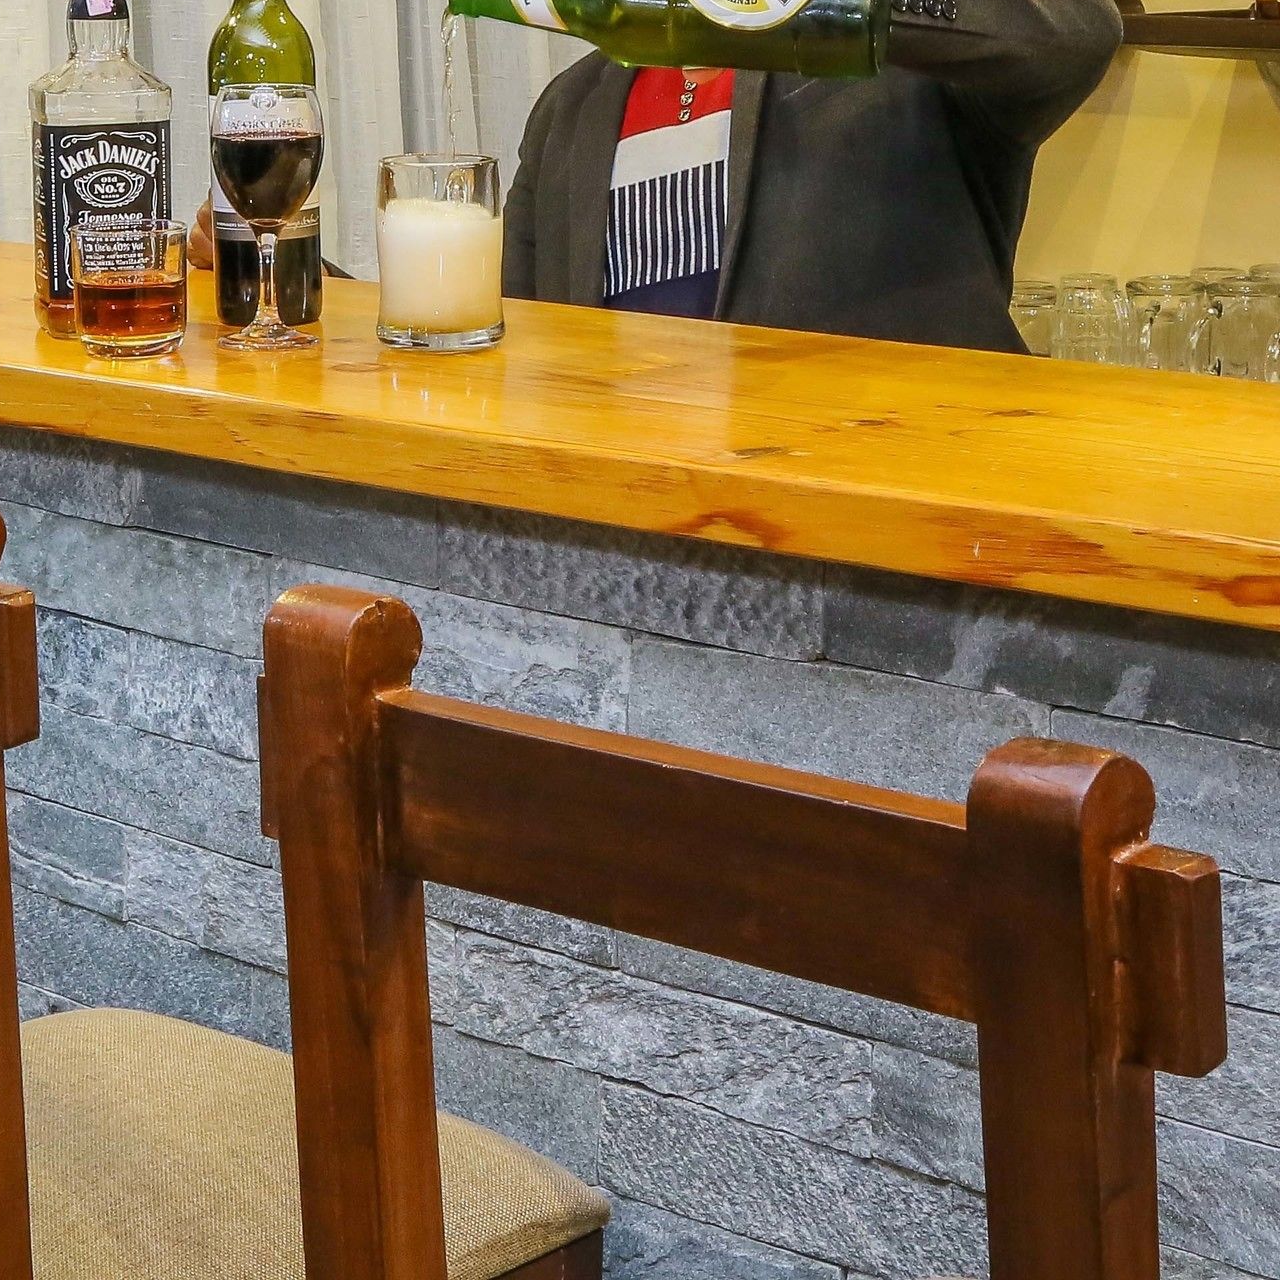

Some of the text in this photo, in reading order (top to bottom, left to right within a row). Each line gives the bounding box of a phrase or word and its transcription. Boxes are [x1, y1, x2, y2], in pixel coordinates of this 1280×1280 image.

[58, 140, 160, 179] JACK DANIEL'S
[78, 210, 143, 225] Tennessee
